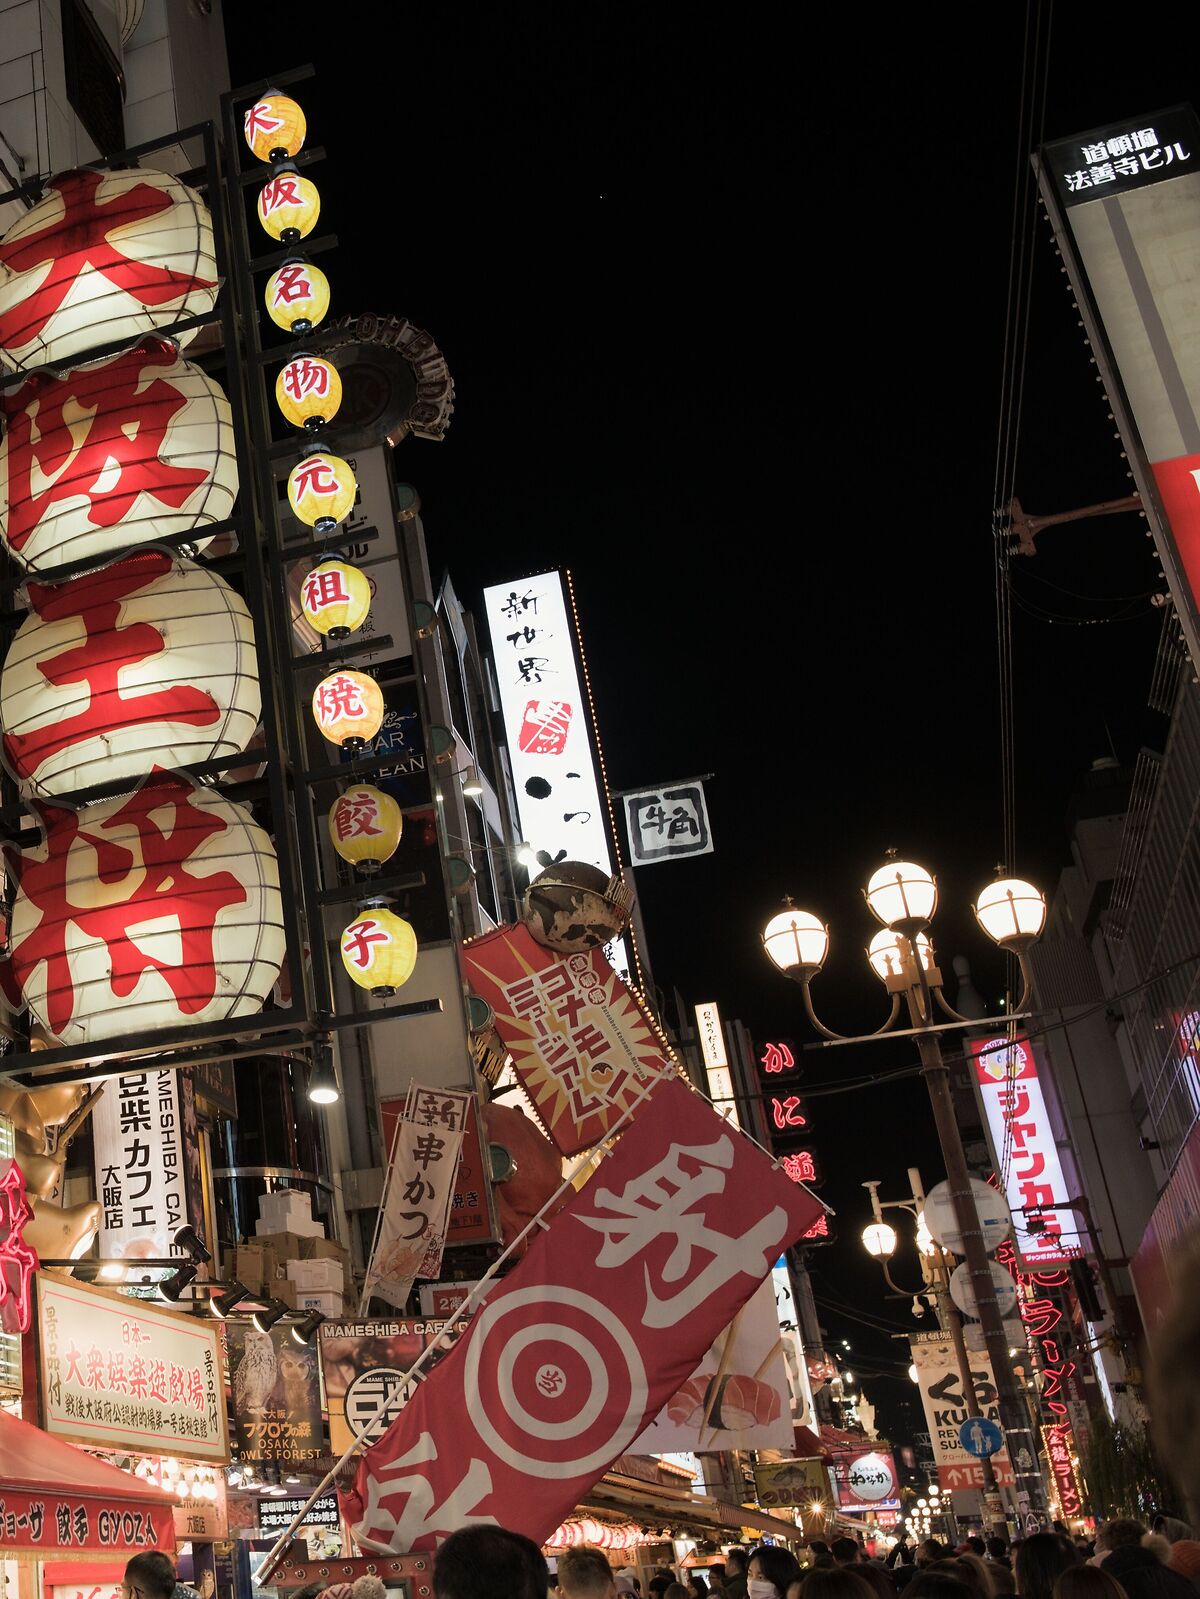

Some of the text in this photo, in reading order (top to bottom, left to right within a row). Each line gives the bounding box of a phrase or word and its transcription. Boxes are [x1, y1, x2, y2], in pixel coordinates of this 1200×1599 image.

[1064, 142, 1191, 193] 法善寺ビル
[1081, 127, 1159, 165] 道頓堀
[501, 589, 559, 686] 新世界
[641, 806, 699, 840] 牛角
[506, 978, 607, 1121] ミュージアム
[538, 964, 629, 1099] コナモン
[157, 1069, 179, 1184] AMESHIBA
[418, 1095, 460, 1131] 新
[118, 1074, 156, 1227] 豆柴カフェ
[997, 1085, 1063, 1248] ジャンカラ
[101, 1165, 124, 1229] 大阪店
[400, 1132, 445, 1240] 串かつ
[569, 1134, 788, 1328] 射
[122, 1322, 150, 1347] 日本一
[324, 1324, 409, 1338] MAMESHIBA
[413, 1323, 454, 1335] CAFE
[64, 1344, 205, 1412] 大衆娯楽遊戯場
[204, 1350, 218, 1433] 景品付
[928, 1371, 999, 1407] くら
[243, 1422, 312, 1439] フクロウの森
[268, 1409, 286, 1420] 大阪
[934, 1406, 1000, 1426] KUA
[258, 1438, 298, 1449] OSAKA
[276, 1448, 321, 1460] FOREST
[56, 1504, 89, 1545] 餃子
[98, 1510, 158, 1546] GYOZA
